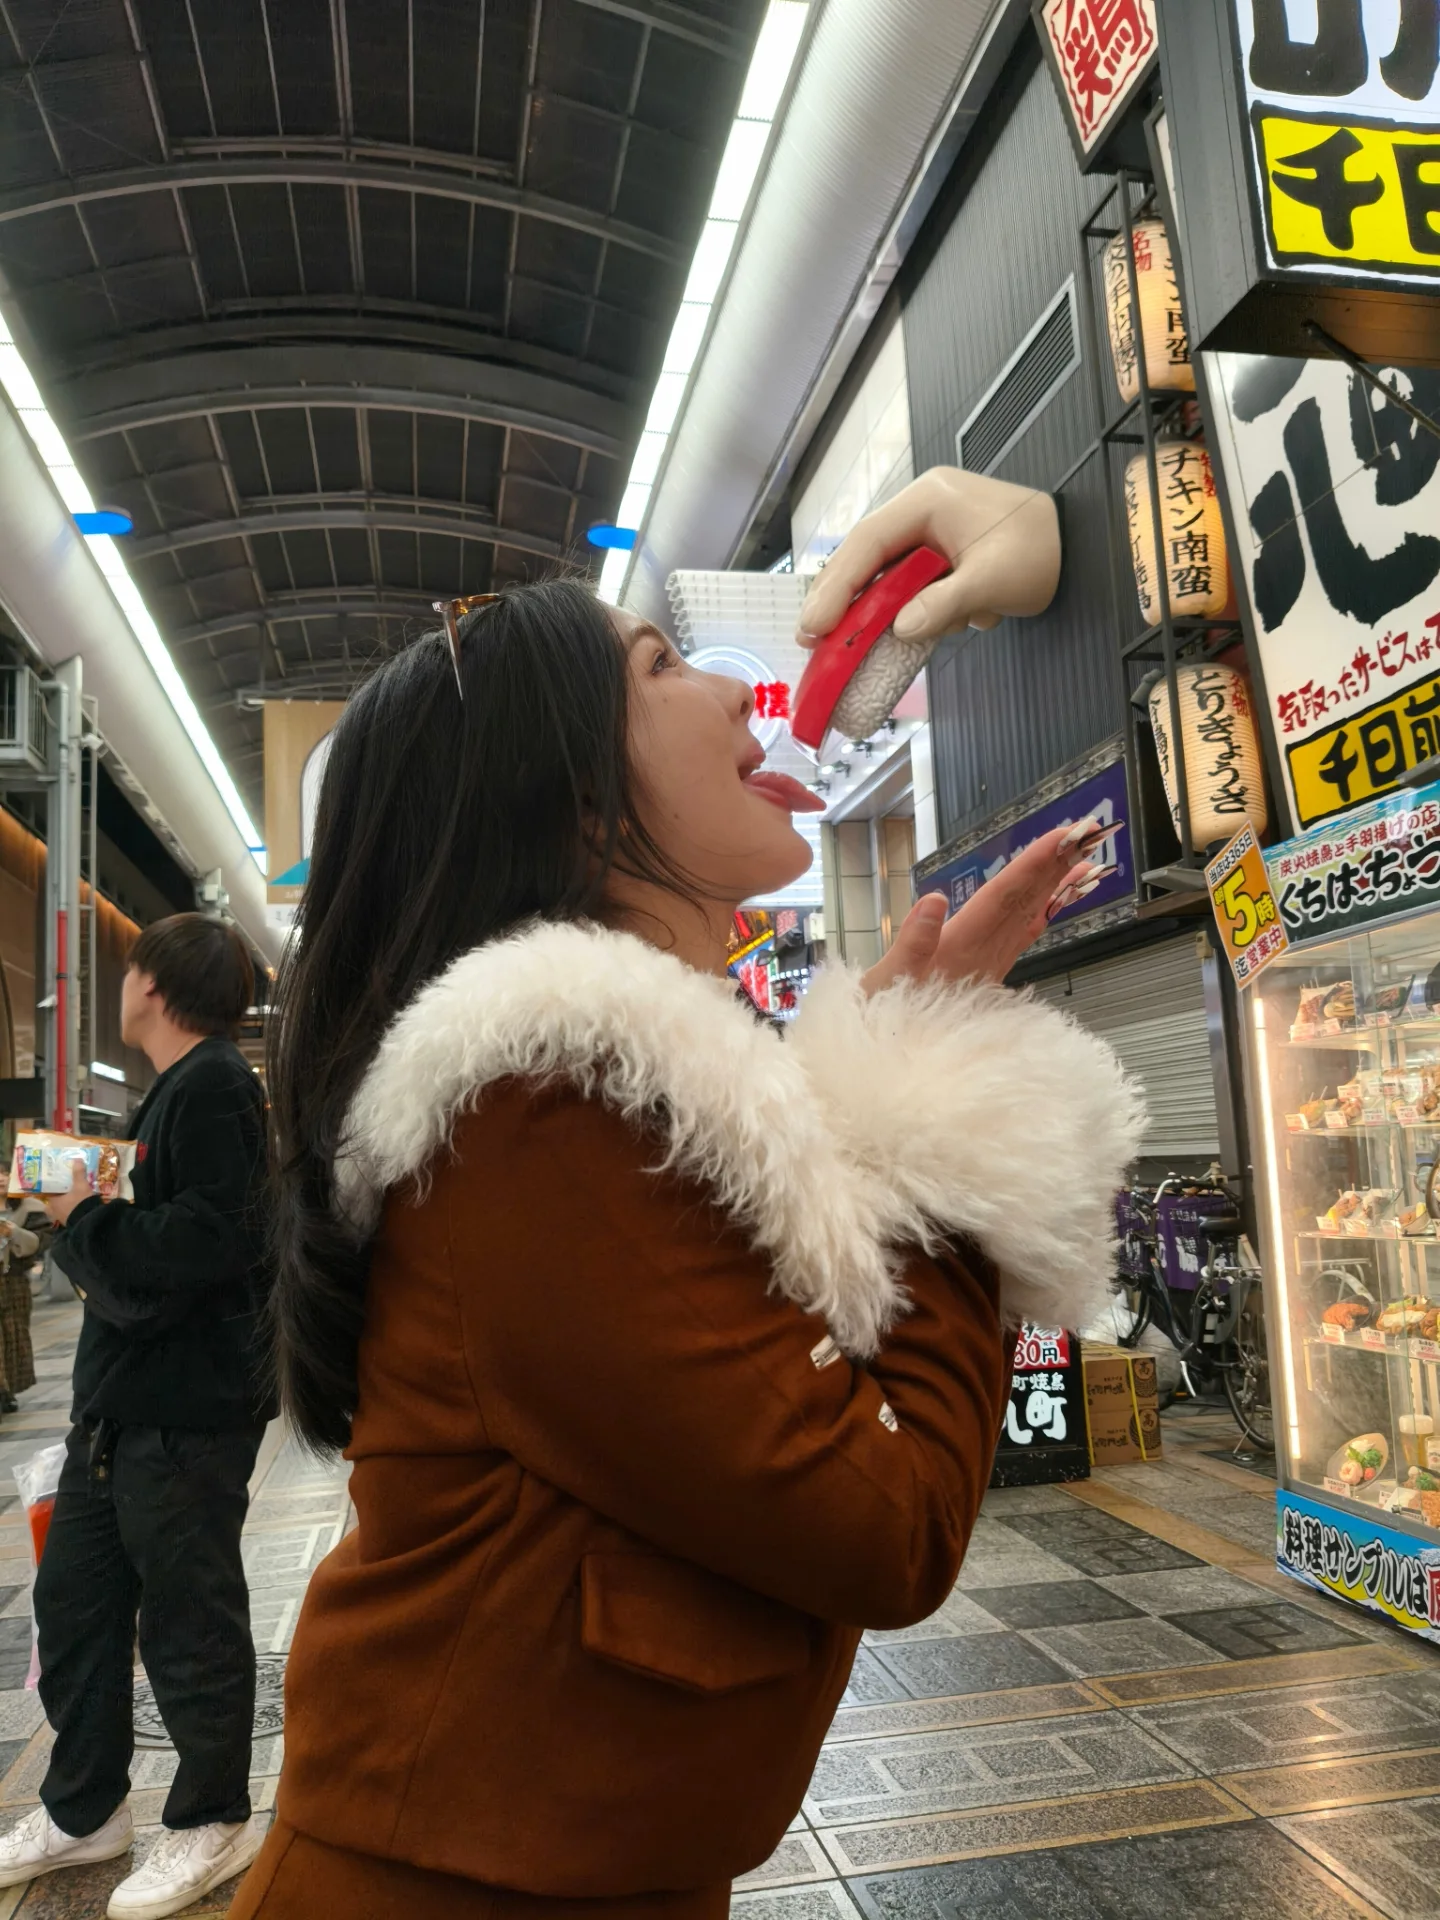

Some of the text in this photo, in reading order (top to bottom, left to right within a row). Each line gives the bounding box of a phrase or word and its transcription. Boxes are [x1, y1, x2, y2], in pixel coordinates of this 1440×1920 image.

[1161, 447, 1213, 598] チキン南蛮
[1190, 669, 1249, 814] とりぎょうざ
[1208, 831, 1253, 885] 当店は365日
[1280, 804, 1438, 877] 炭火焼鳥と手羽揚げの店
[1234, 926, 1283, 980] 迄営業中
